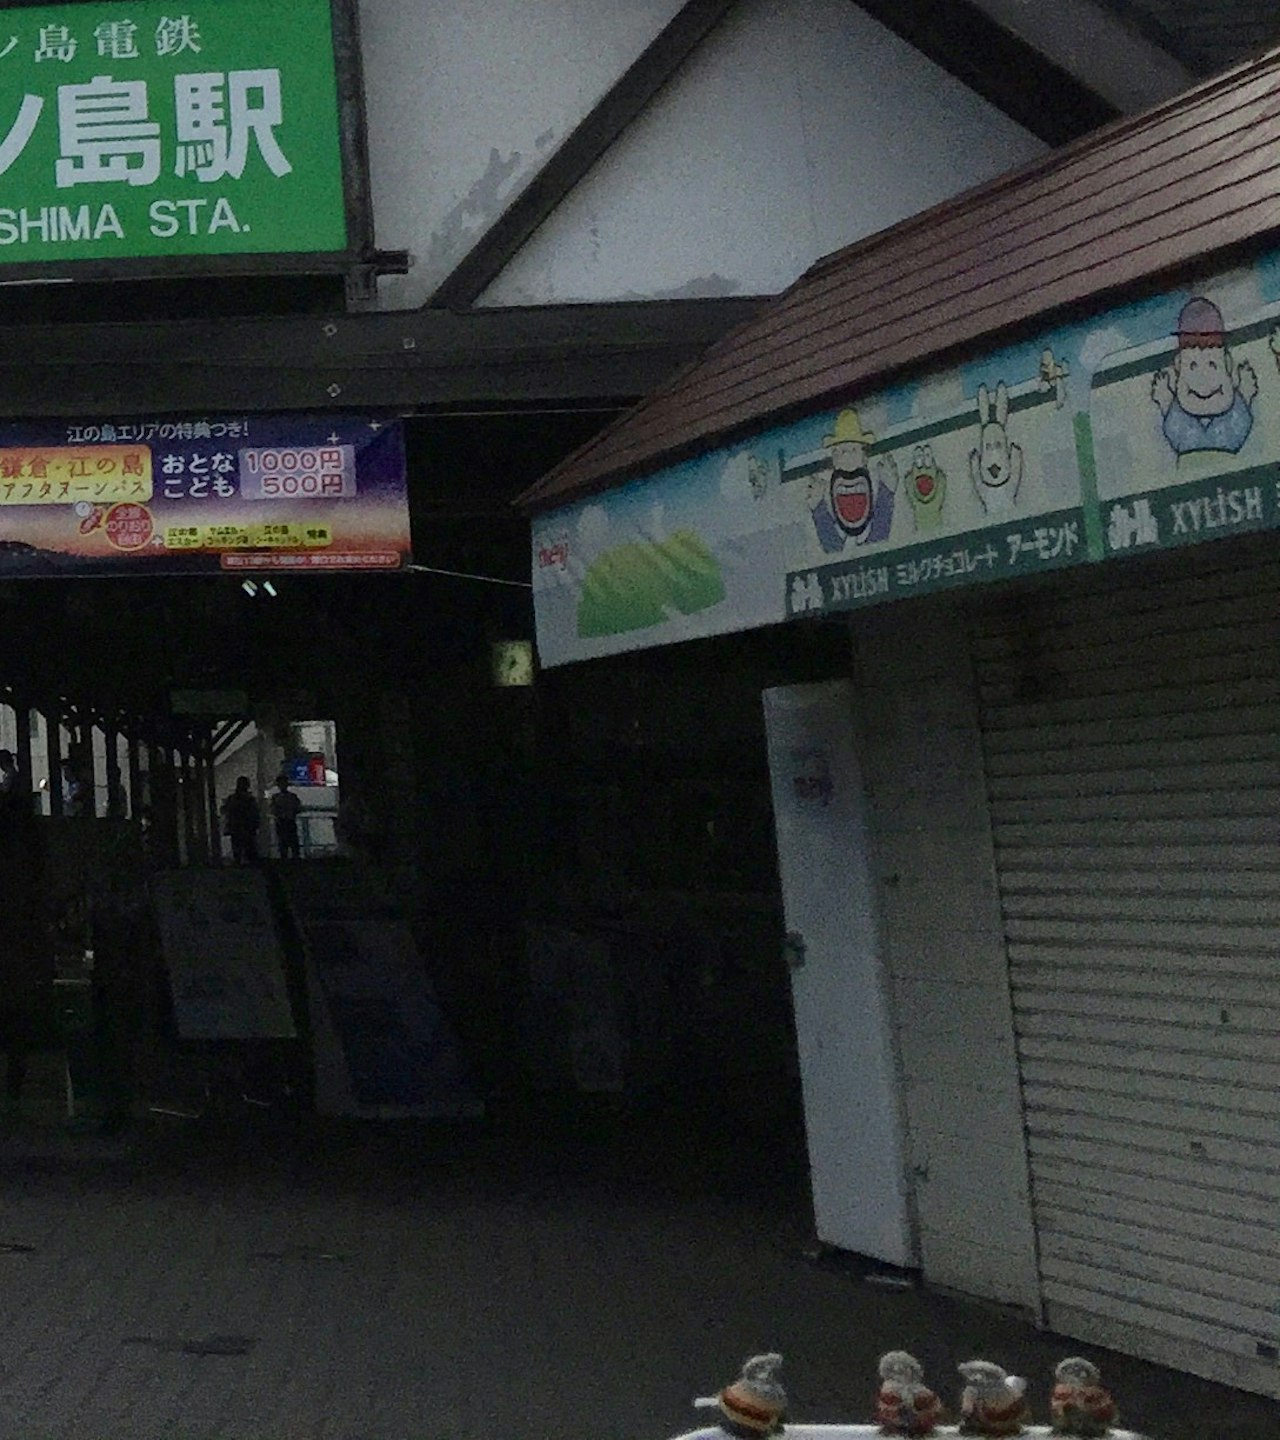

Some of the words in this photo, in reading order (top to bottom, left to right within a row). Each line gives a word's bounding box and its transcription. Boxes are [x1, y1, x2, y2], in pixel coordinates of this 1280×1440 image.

[149, 198, 250, 237] STA.
[162, 452, 235, 474] おとな
[247, 449, 343, 473] 1000円
[164, 475, 235, 498] こども
[263, 473, 344, 495] 500円
[896, 547, 998, 586] ミルクチョコレート
[1006, 521, 1079, 565] アーモンド
